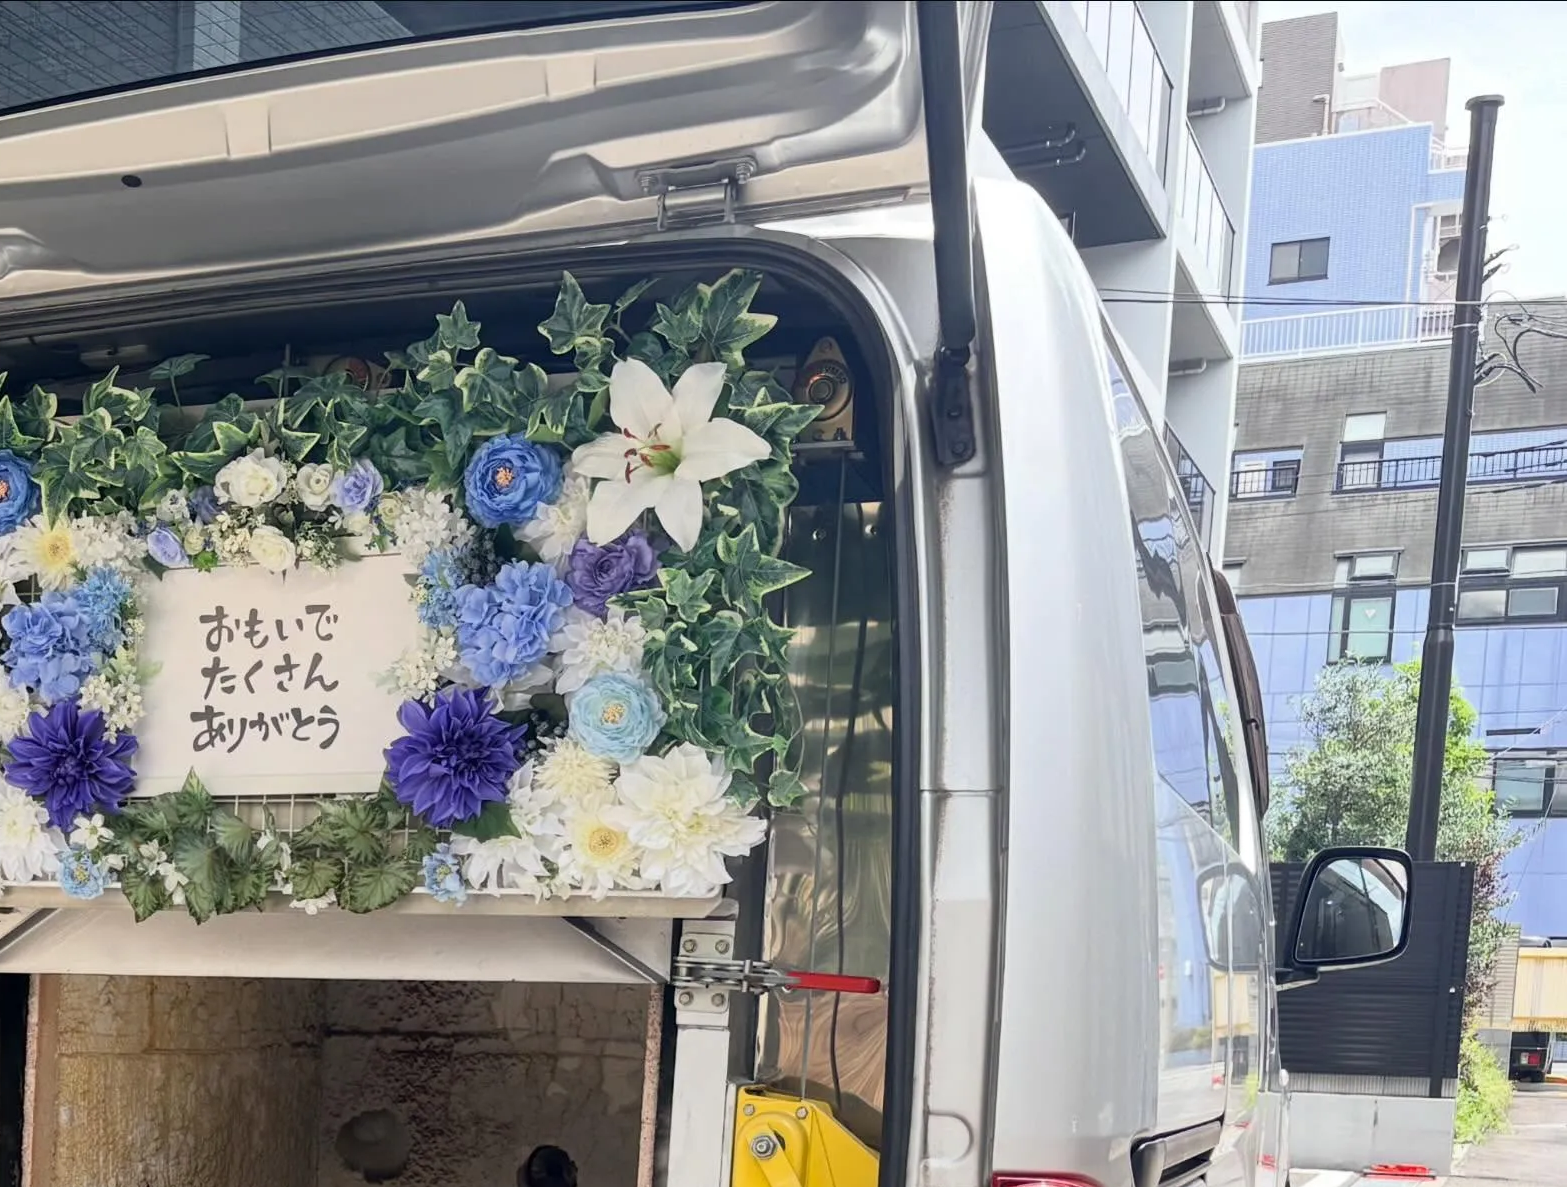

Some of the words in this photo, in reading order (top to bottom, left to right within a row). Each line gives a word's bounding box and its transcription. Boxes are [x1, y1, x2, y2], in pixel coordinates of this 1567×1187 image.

[199, 604, 339, 652] おもいで
[201, 652, 339, 700] たくさん
[190, 704, 340, 753] ありがとう
